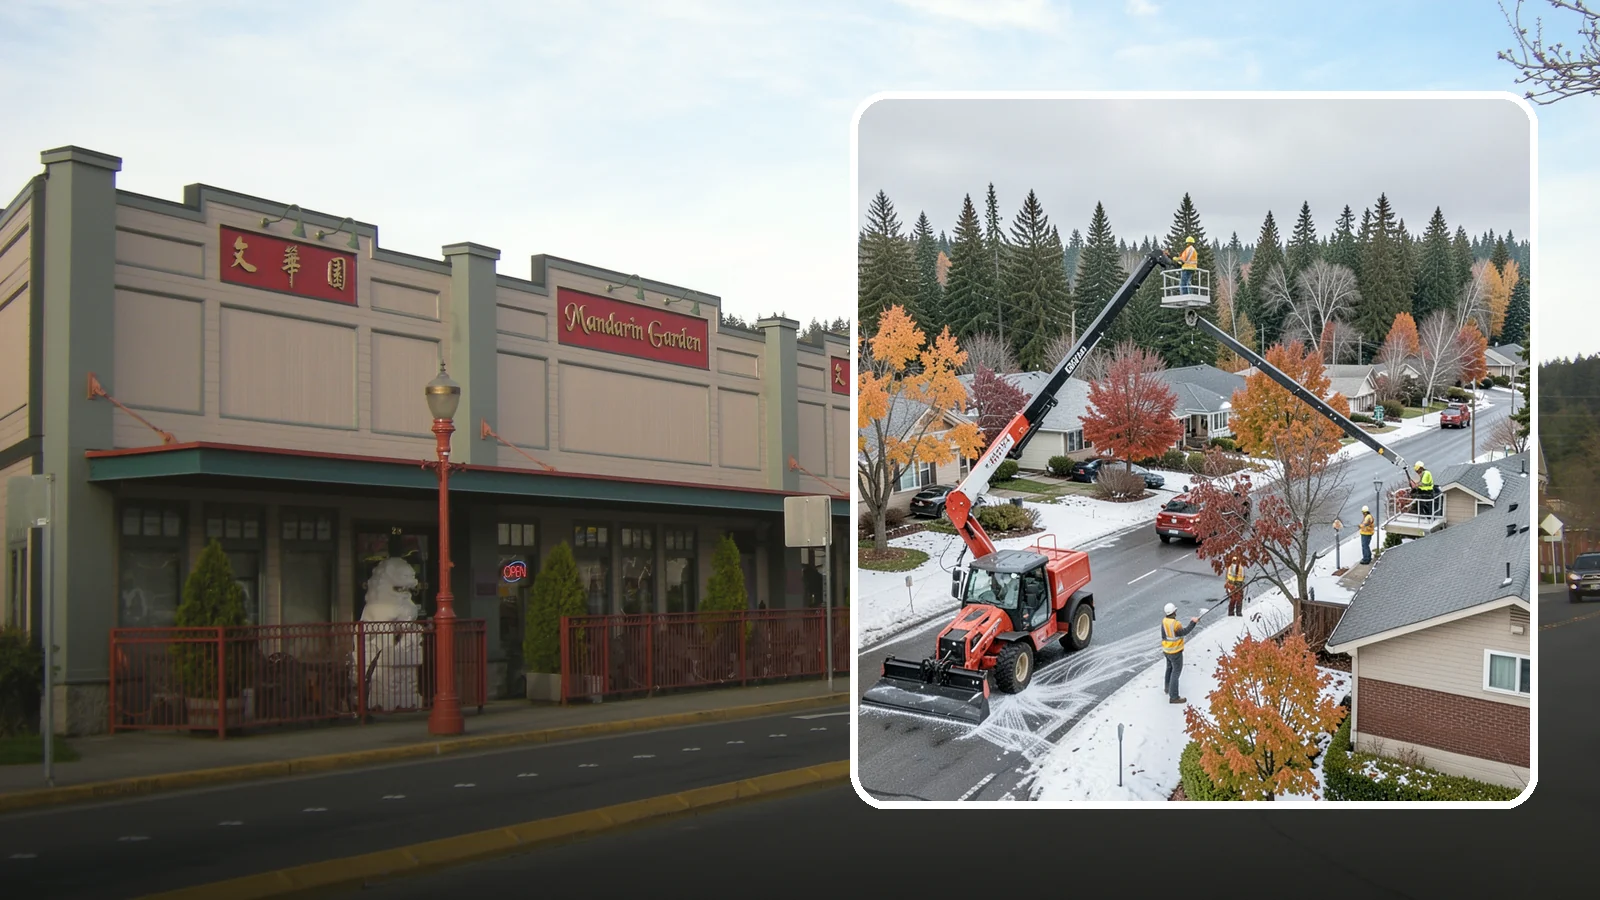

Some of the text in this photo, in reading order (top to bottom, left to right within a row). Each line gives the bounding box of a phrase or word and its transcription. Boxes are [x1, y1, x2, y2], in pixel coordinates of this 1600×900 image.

[231, 236, 346, 291] 文華園
[564, 302, 702, 352] Mandarin Garden
[503, 565, 527, 578] OPEN
